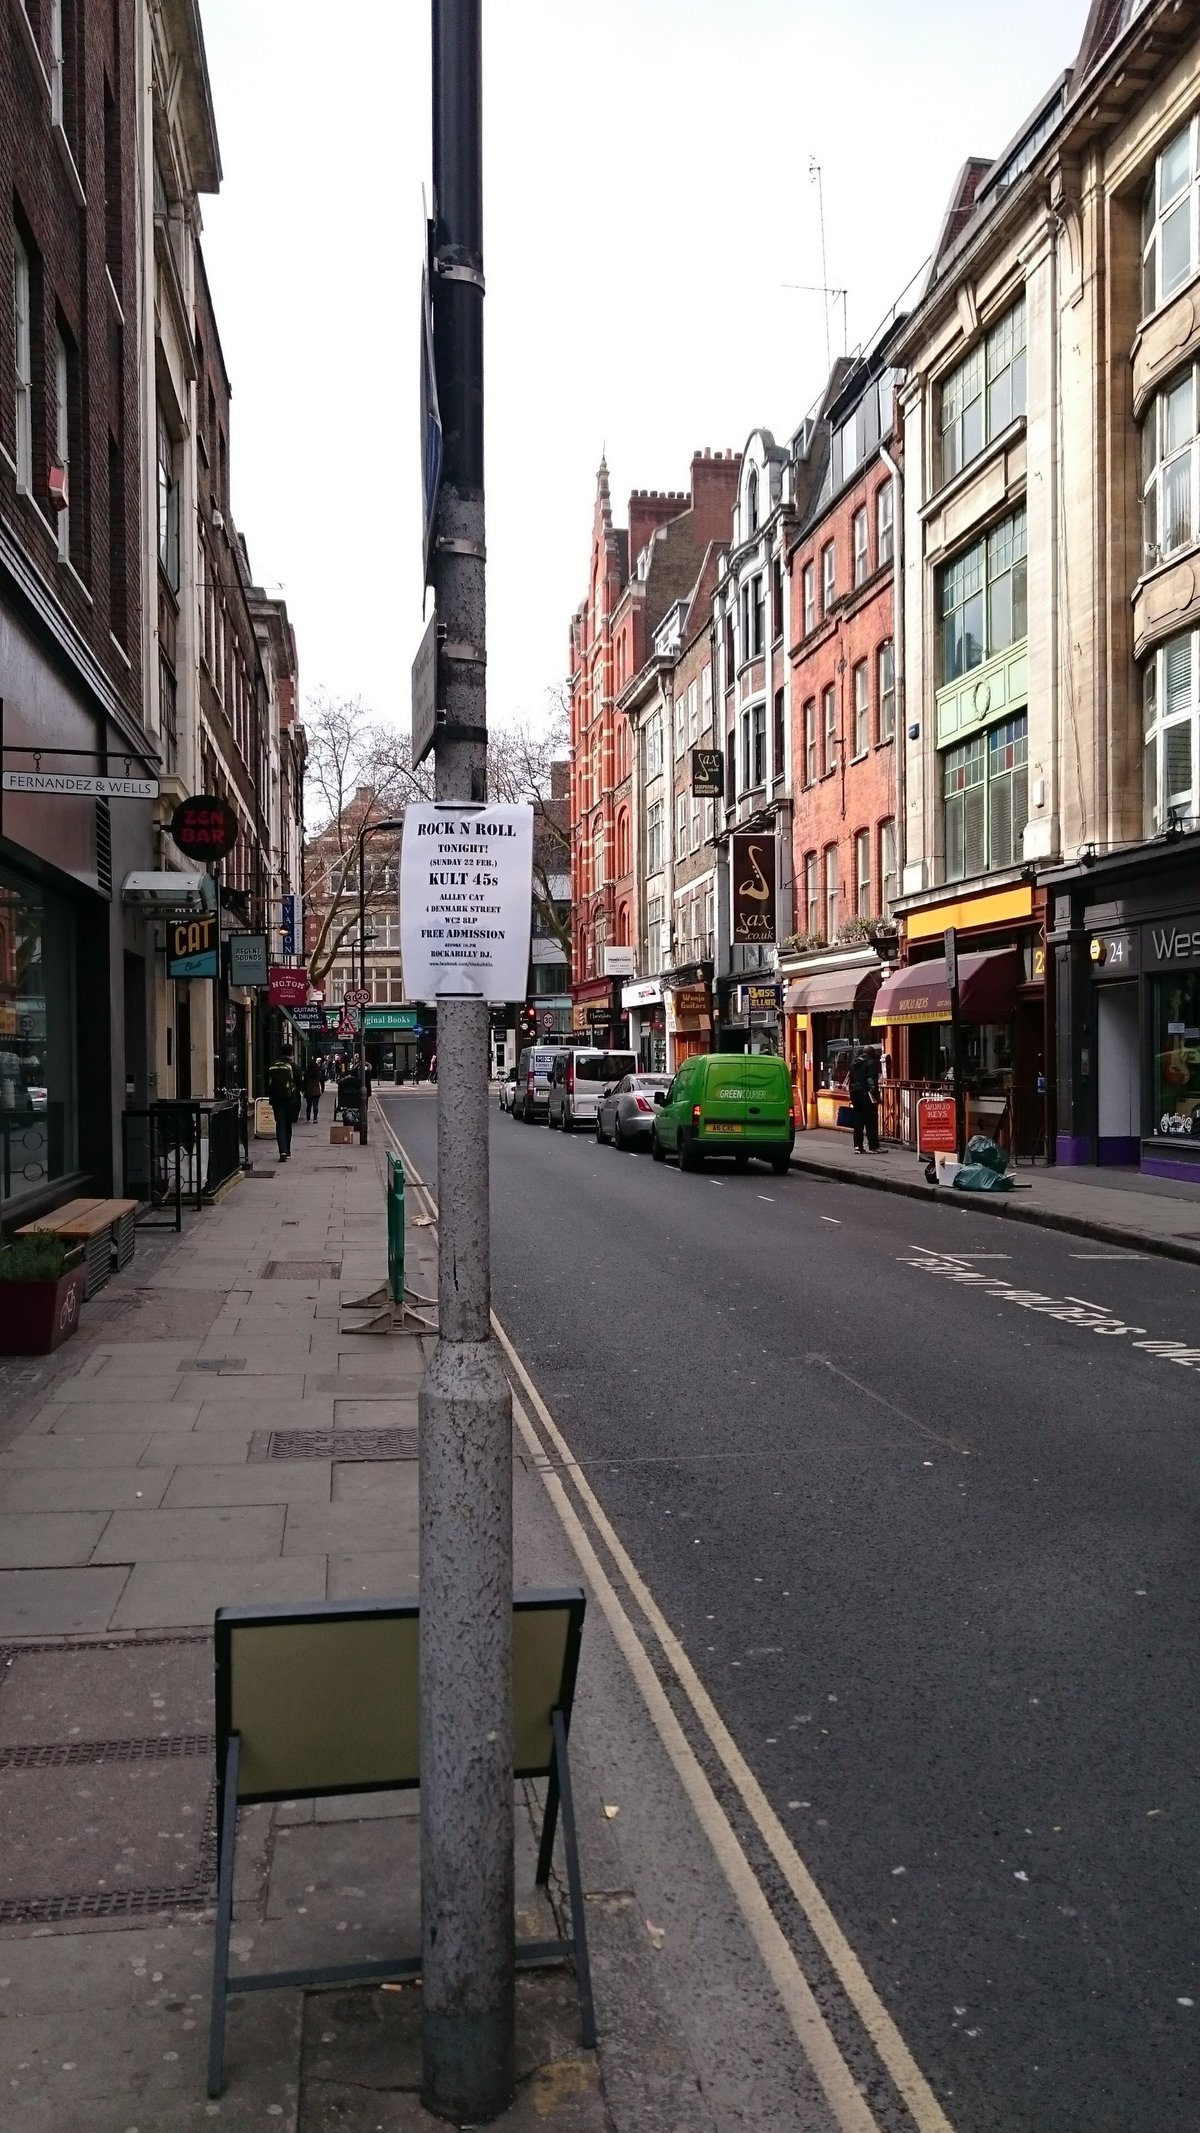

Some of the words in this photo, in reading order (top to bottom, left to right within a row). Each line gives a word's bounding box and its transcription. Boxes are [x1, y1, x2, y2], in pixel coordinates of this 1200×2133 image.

[10, 775, 92, 791] FERNANDEZ
[95, 781, 105, 792] &
[109, 781, 151, 794] WELLS
[184, 810, 224, 824] ZEN
[417, 822, 455, 836] ROCK
[460, 822, 470, 835] N
[476, 823, 516, 837] ROLL
[180, 828, 224, 843] BAR
[438, 844, 488, 854] TONIGHT!
[429, 859, 462, 867] (SUNDAY
[476, 859, 498, 867] FEB.)
[429, 873, 468, 885] KULT
[473, 873, 499, 886] 45s
[431, 905, 468, 913] DENMARK
[470, 905, 502, 913] STREET
[736, 912, 774, 934] Sax
[175, 918, 216, 955] CAT
[421, 929, 444, 938] FREE
[446, 929, 505, 939] ADMISSION
[745, 930, 774, 940] .co.uk
[430, 950, 478, 958] ROCKABILLY
[1110, 941, 1123, 962] 24
[1035, 950, 1044, 973] 2
[272, 980, 304, 989] NO.TOM
[748, 987, 775, 998] BASS
[682, 994, 705, 1004] Wunjo
[750, 998, 776, 1006] ELLAR
[680, 1001, 707, 1010] Guitars
[388, 1016, 410, 1024] Books
[896, 1256, 1013, 1286] PERMIT
[985, 1290, 1148, 1335] HOLDERS
[1131, 1340, 1200, 1372] ONL
